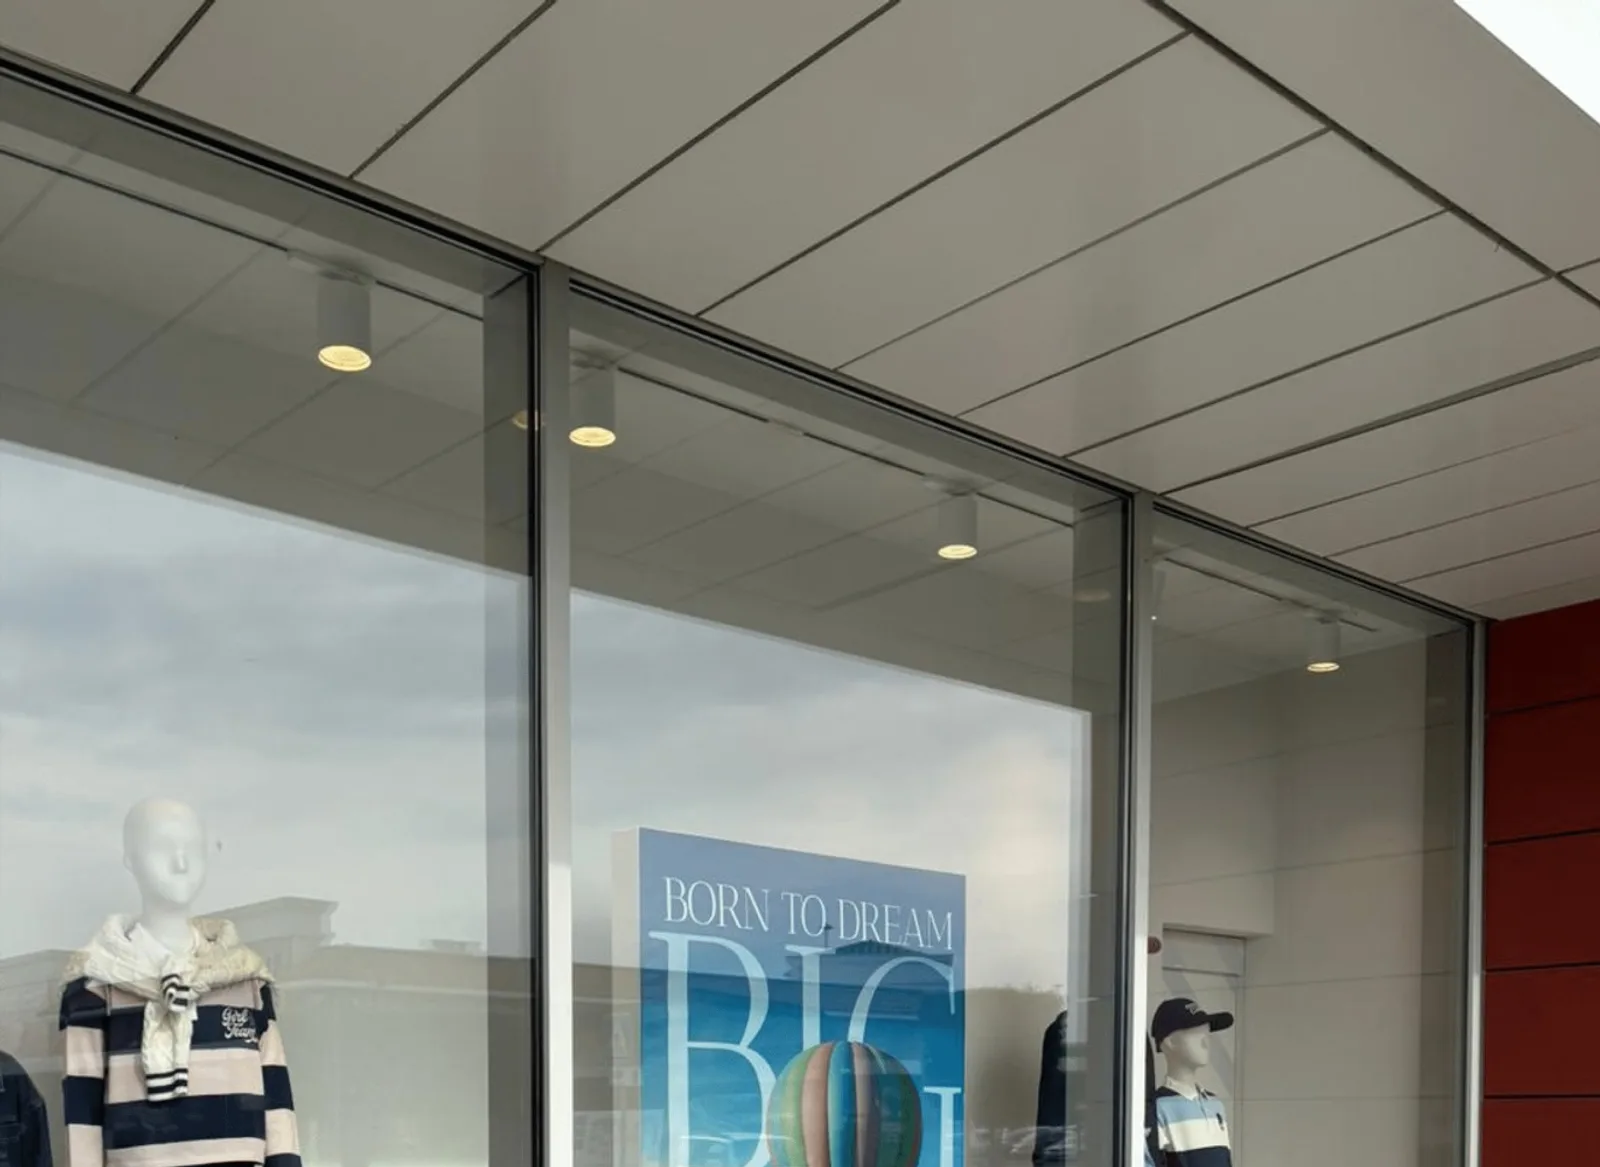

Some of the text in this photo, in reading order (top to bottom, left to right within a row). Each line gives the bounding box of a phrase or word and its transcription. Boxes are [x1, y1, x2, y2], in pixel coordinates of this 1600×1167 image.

[664, 876, 953, 950] BORN TO DREAM
